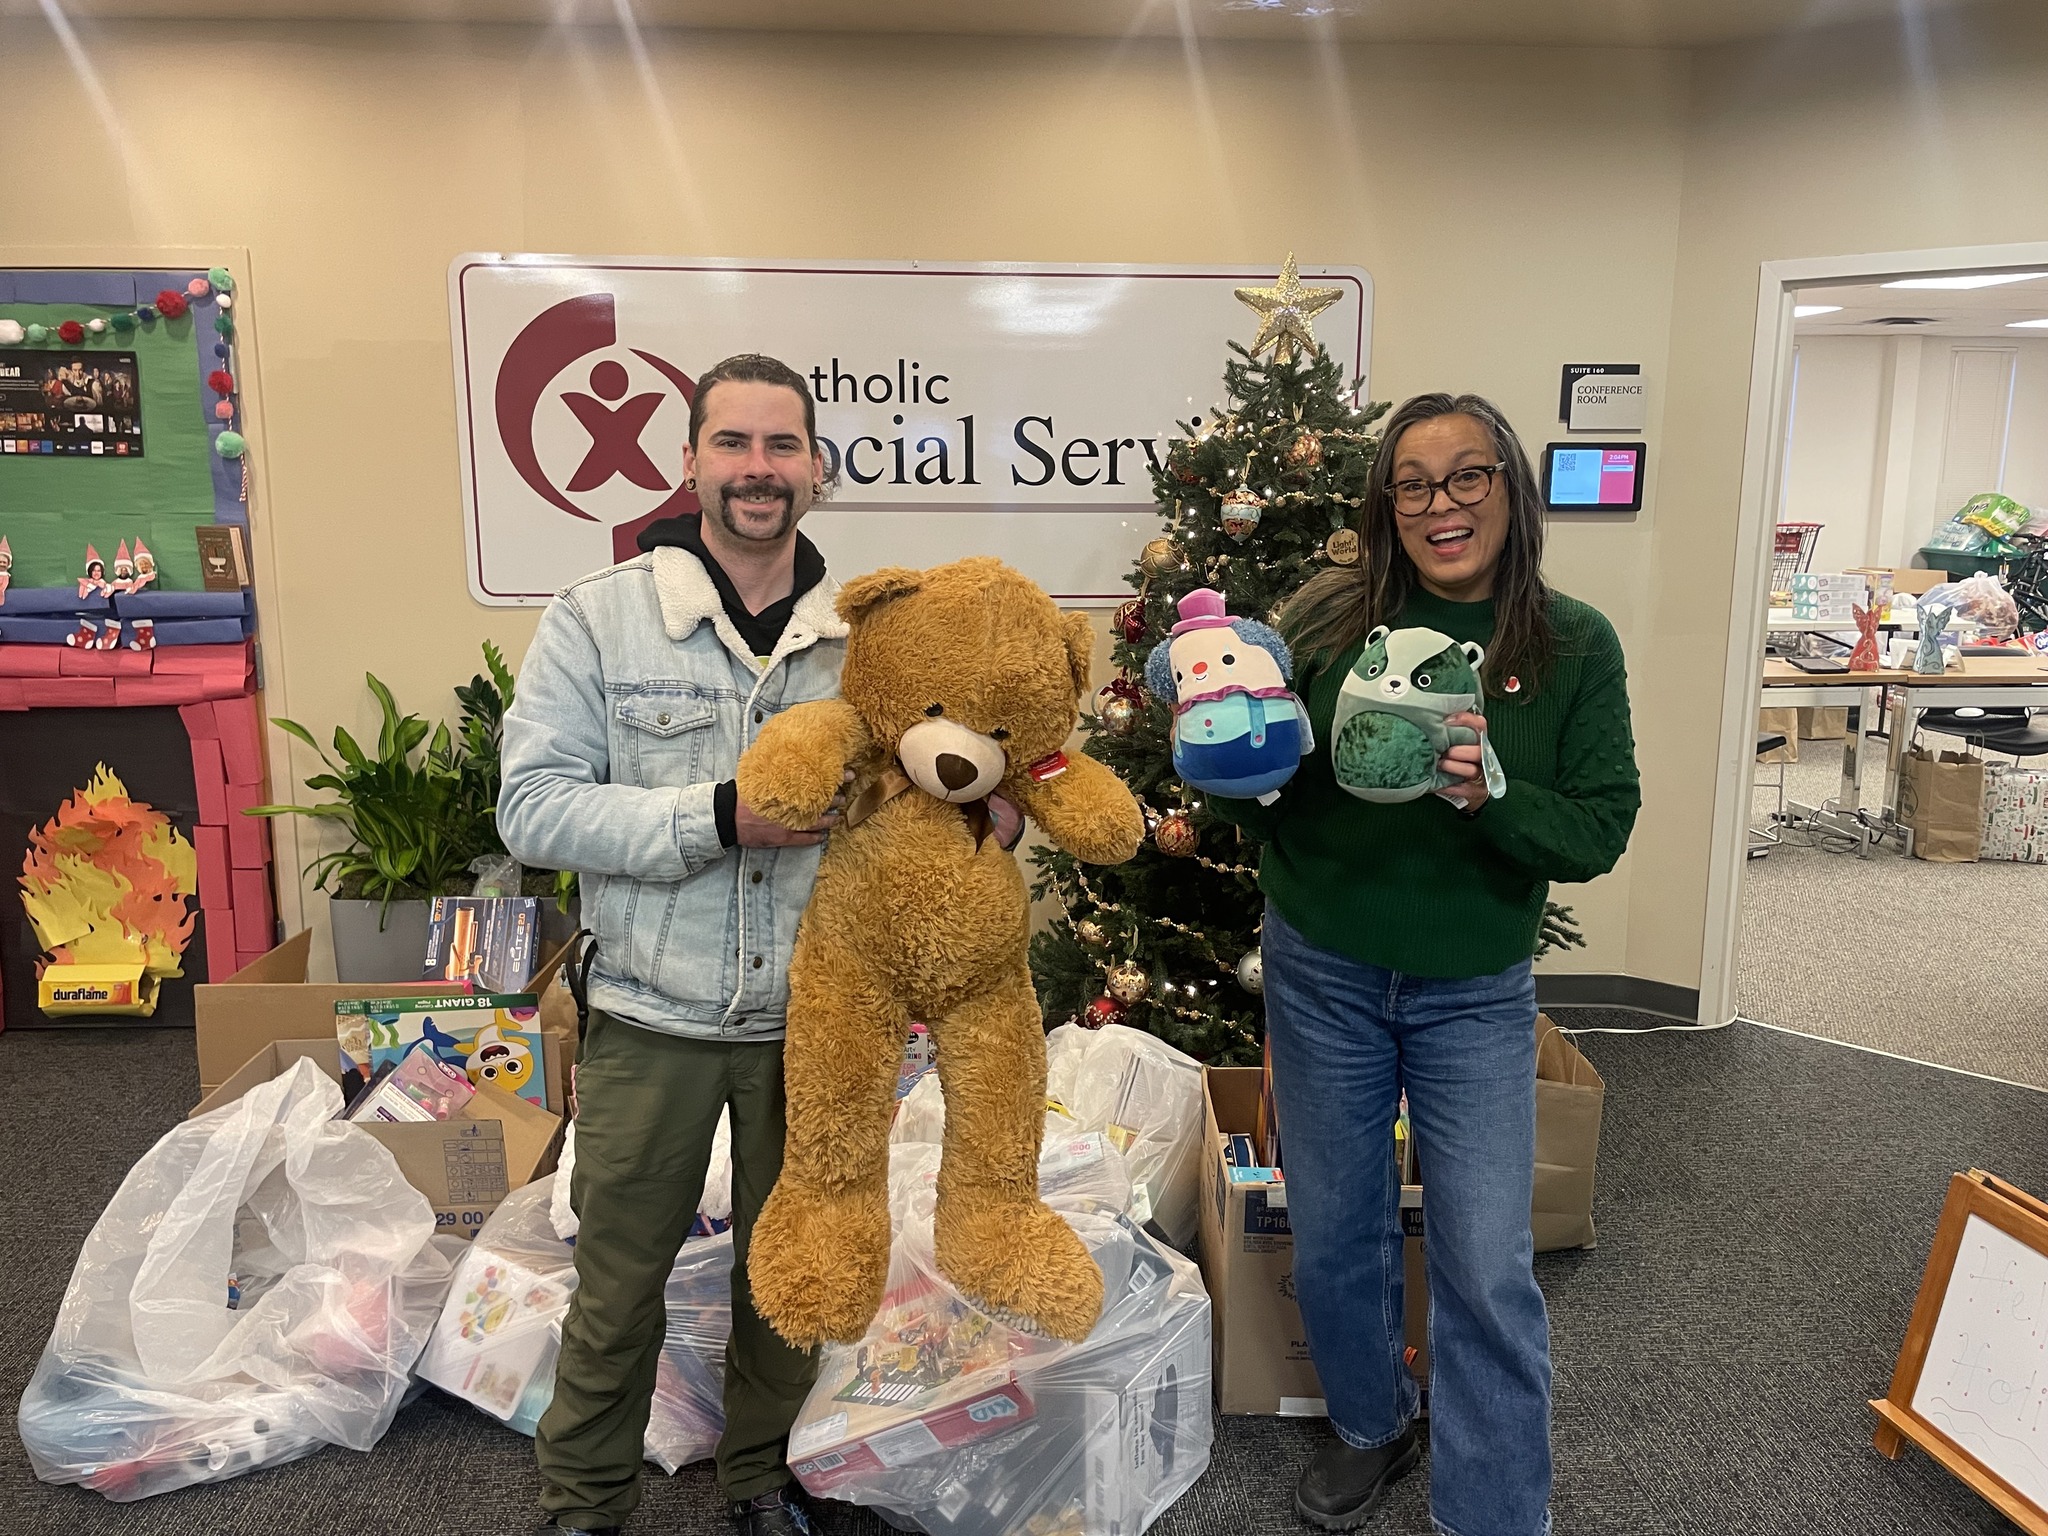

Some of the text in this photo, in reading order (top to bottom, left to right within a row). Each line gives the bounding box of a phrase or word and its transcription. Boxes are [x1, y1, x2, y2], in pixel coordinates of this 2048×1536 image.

[809, 357, 950, 405] tholic
[1577, 385, 1643, 395] CONFERENCE
[1576, 395, 1608, 405] ROOM
[815, 413, 1202, 487] ocial Serv
[1331, 545, 1358, 556] World
[53, 987, 109, 1002] duraflame
[434, 997, 493, 1009] 18 GIANT
